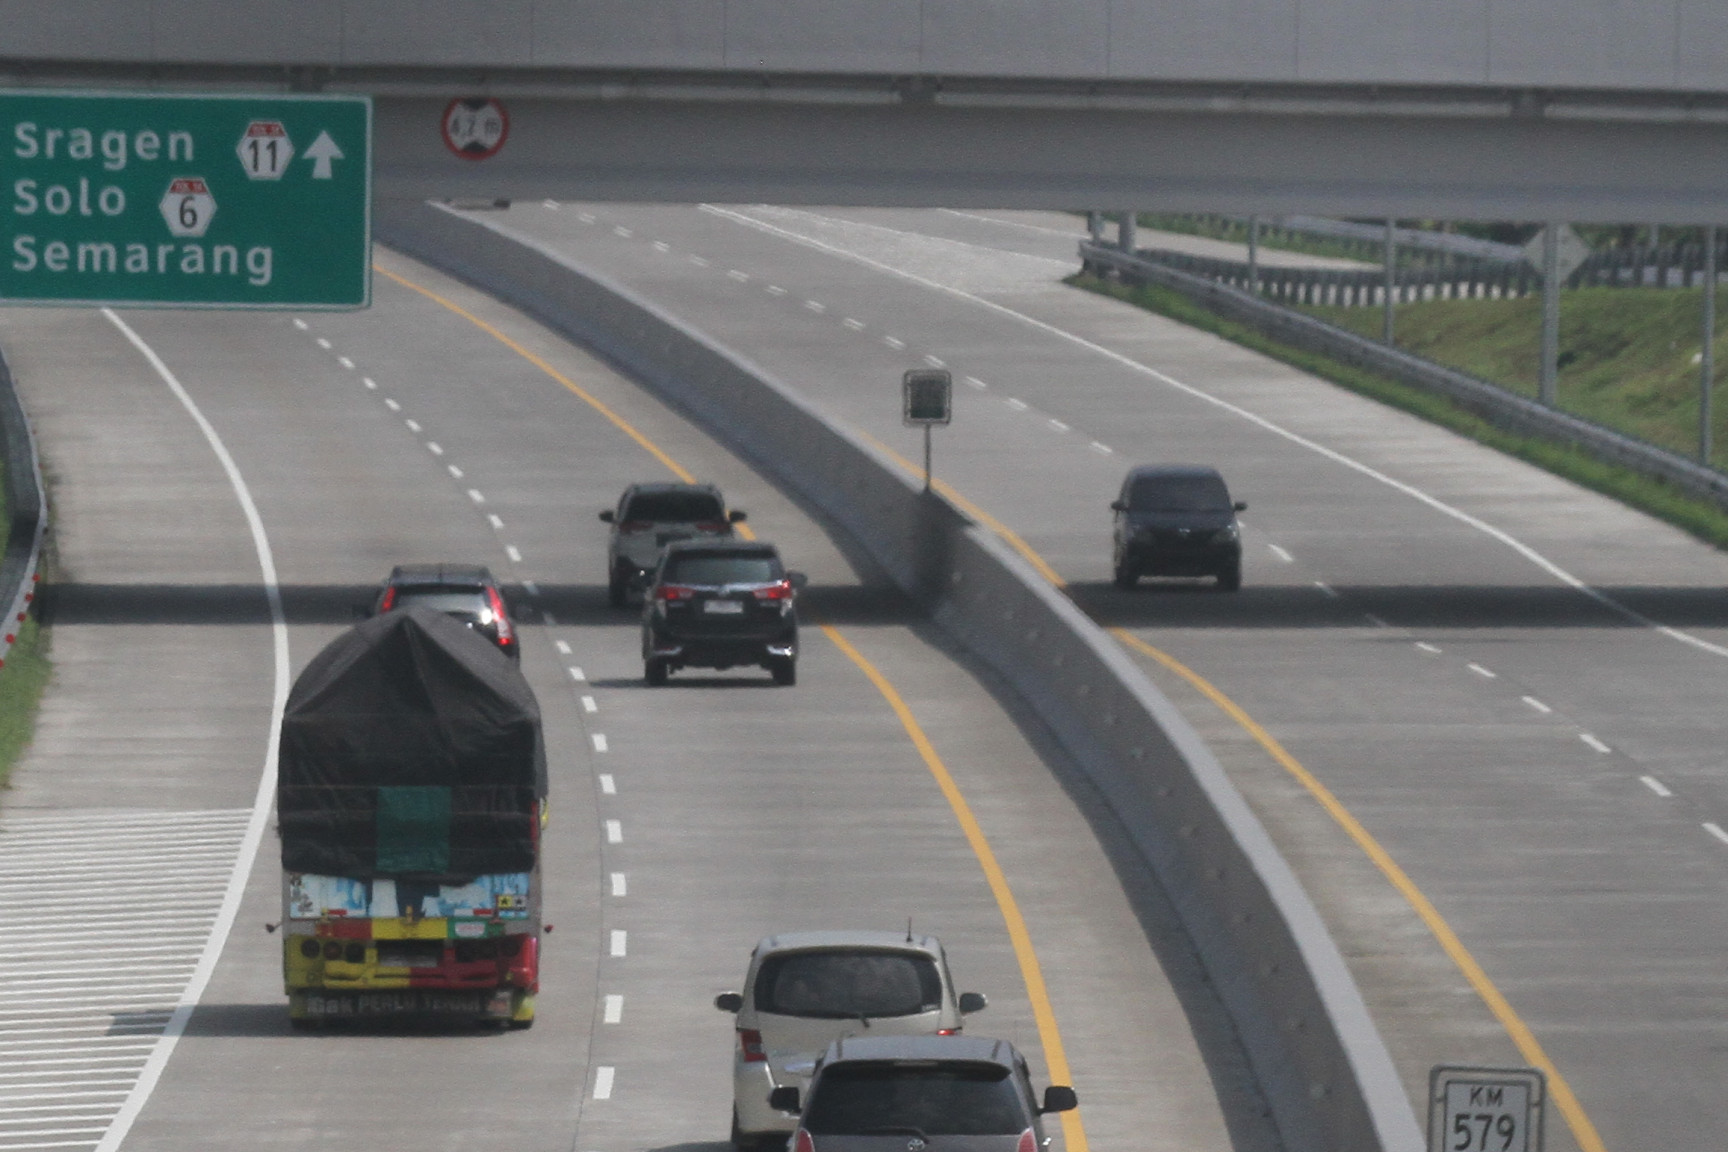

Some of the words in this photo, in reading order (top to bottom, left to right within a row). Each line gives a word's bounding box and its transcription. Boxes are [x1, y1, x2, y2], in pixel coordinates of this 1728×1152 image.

[14, 121, 194, 169] Sragen
[248, 139, 279, 173] 11
[13, 177, 126, 216] Solo
[179, 195, 198, 229] 6
[13, 236, 273, 286] Semarang
[1469, 1087, 1503, 1107] KM
[1453, 1113, 1516, 1152] 579
